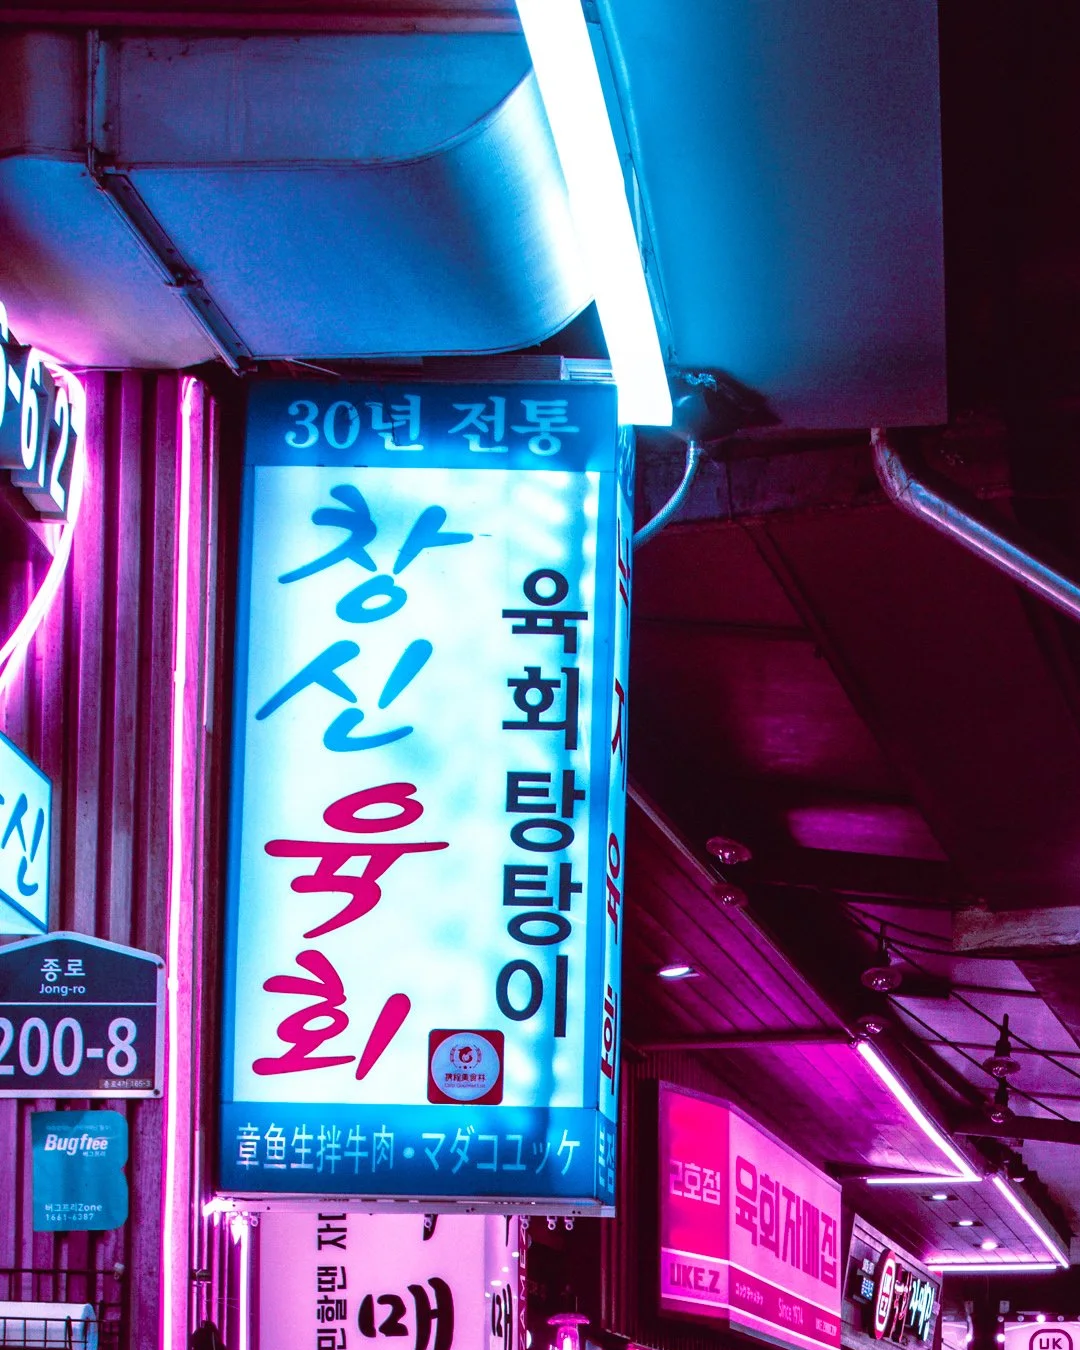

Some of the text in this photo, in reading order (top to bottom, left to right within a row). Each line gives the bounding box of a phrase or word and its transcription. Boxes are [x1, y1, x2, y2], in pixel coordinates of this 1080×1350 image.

[285, 399, 580, 455] 30년 전통
[40, 958, 86, 982] 종로
[39, 983, 86, 996] Jong-ro
[1039, 1337, 1062, 1350] UK
